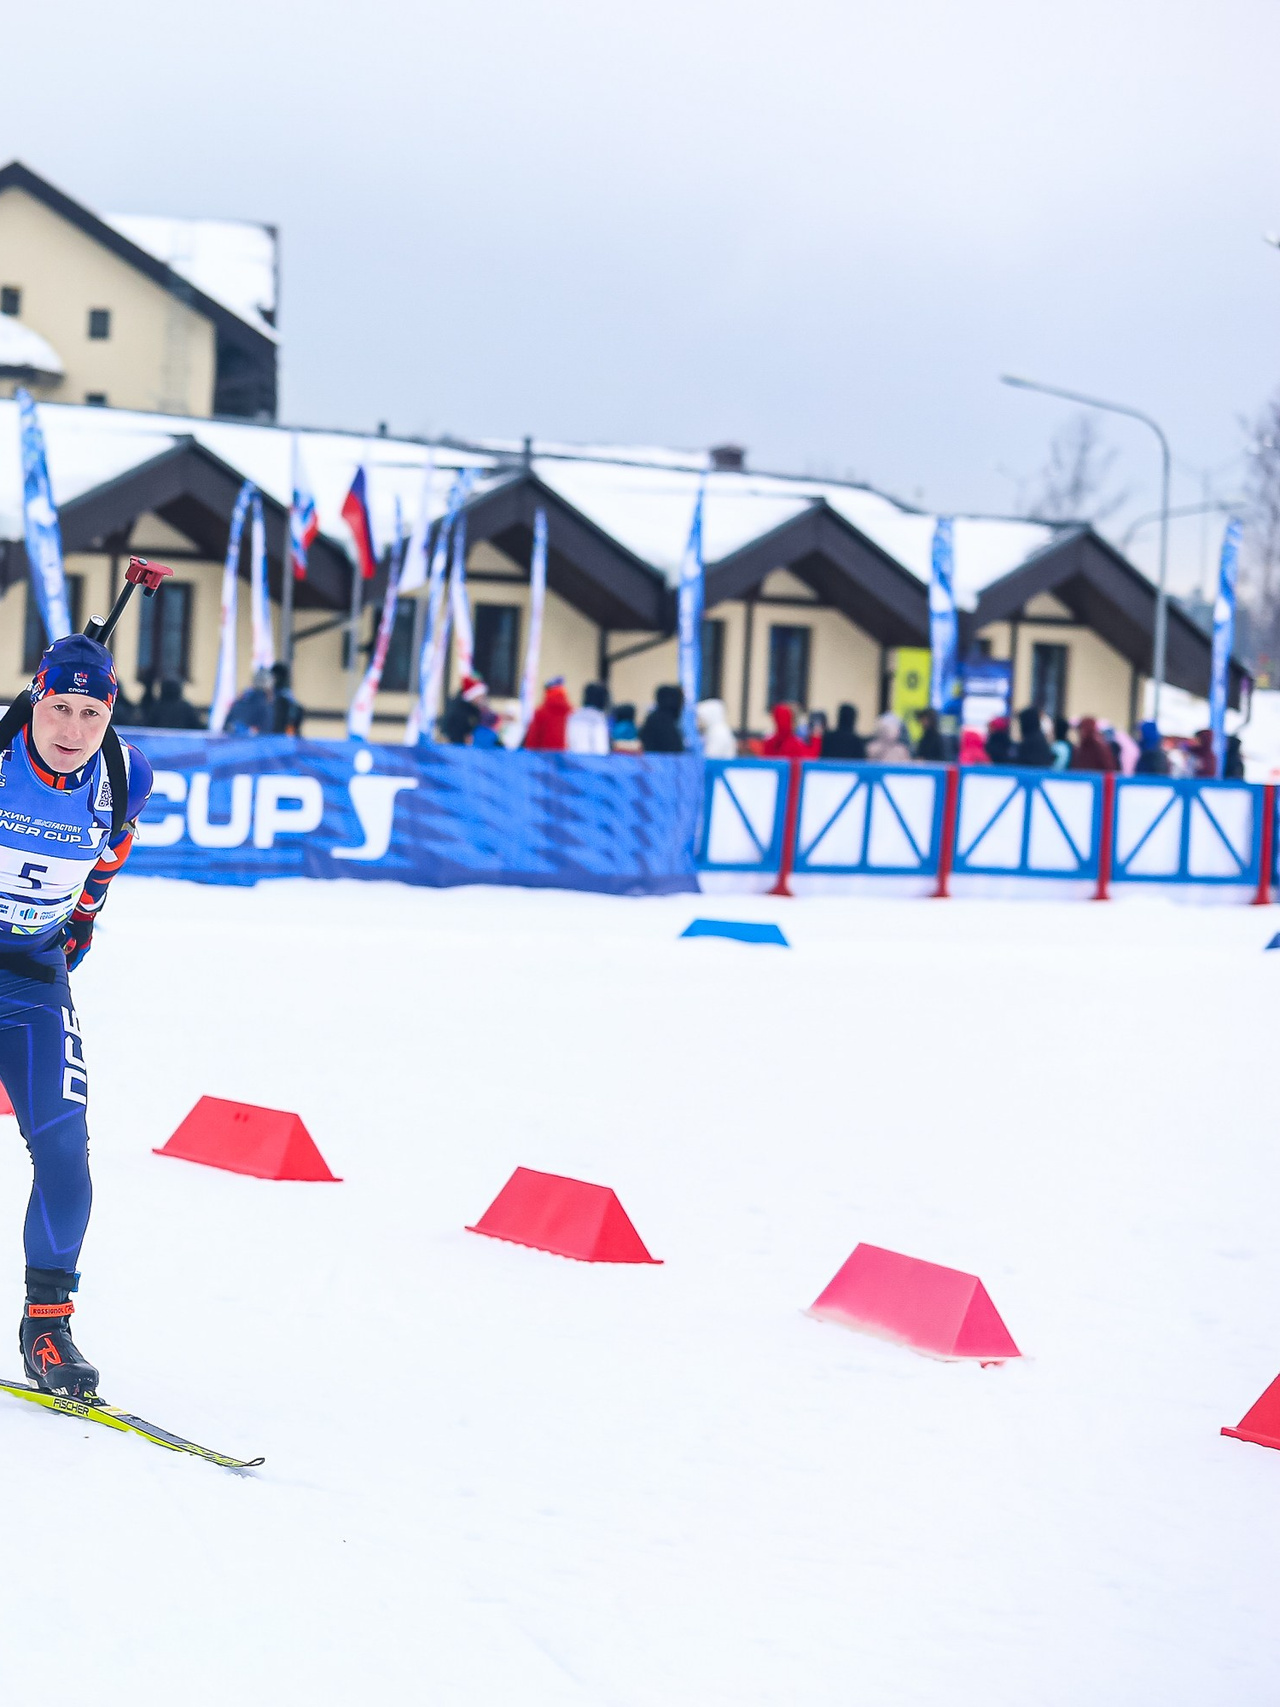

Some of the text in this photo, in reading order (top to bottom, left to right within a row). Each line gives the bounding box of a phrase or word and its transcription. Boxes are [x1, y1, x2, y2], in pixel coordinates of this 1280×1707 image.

[131, 769, 325, 850] CUP
[43, 830, 82, 843] CUP
[18, 862, 49, 889] 5
[32, 1306, 64, 1315] ROSSIGNOL
[53, 1398, 90, 1417] FISCHER
